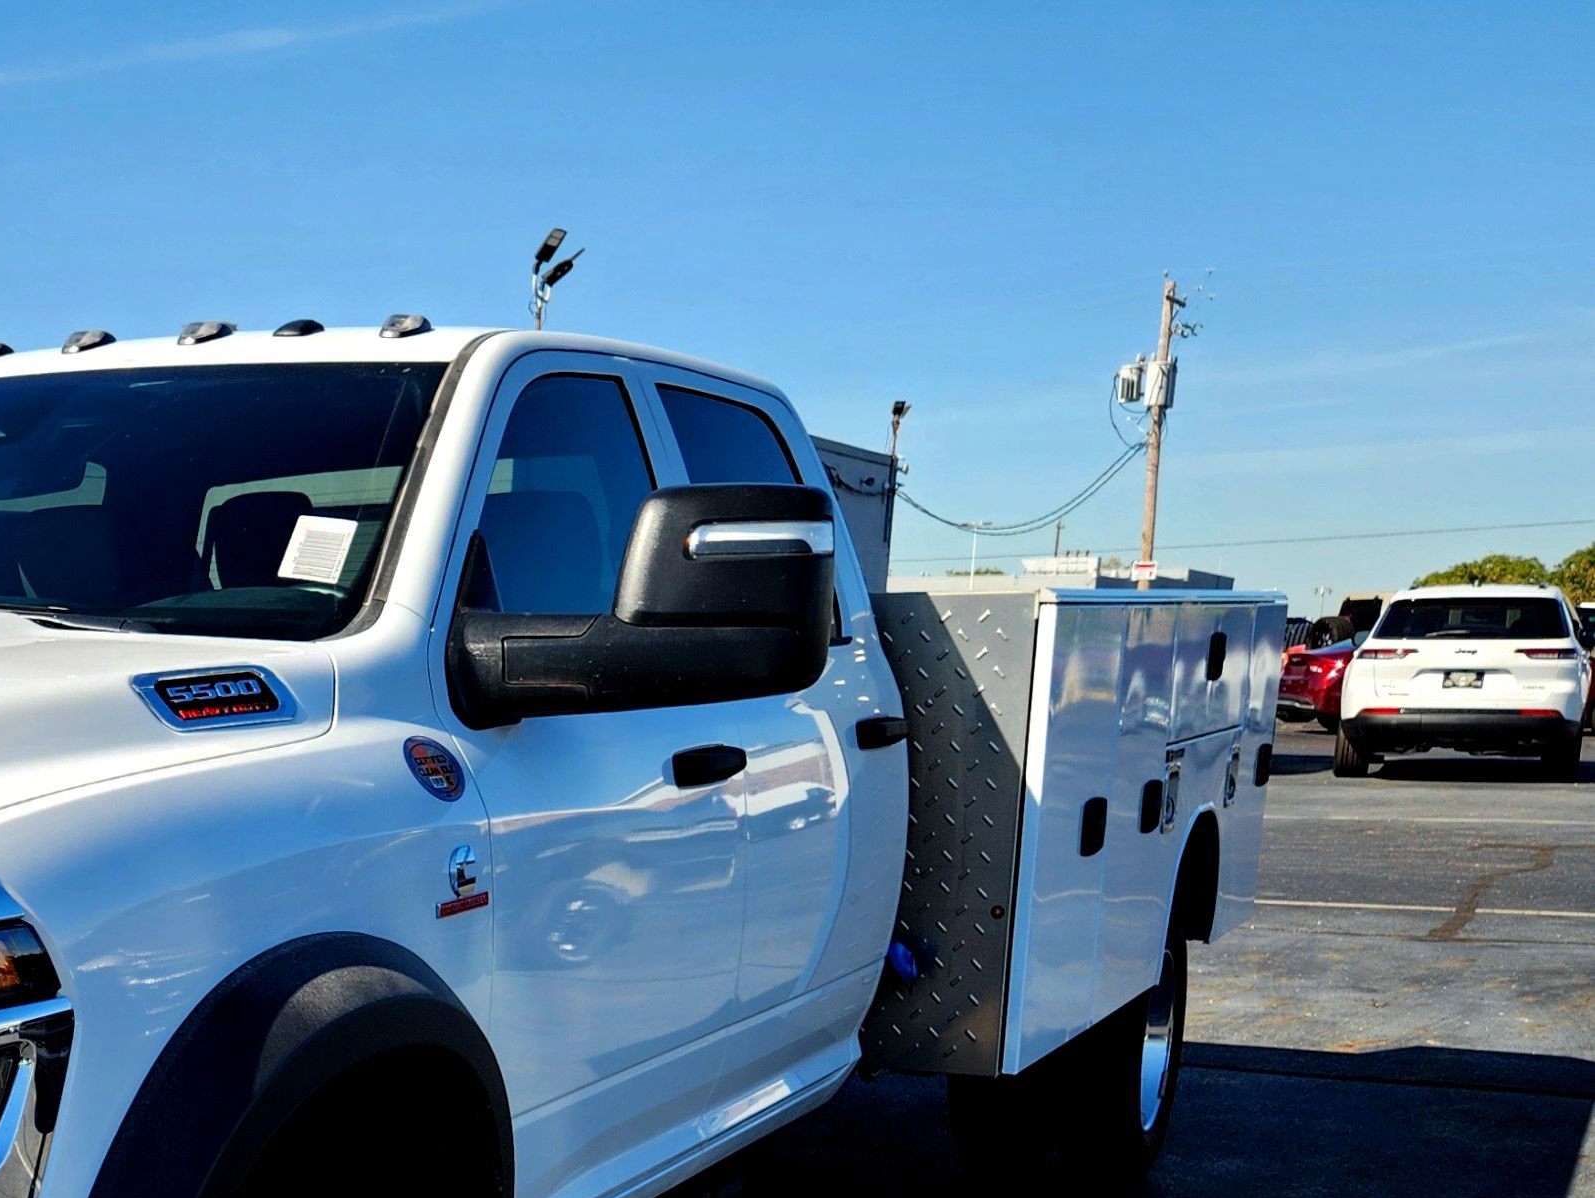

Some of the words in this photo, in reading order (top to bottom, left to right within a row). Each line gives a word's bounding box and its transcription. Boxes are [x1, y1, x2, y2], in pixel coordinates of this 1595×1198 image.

[1454, 648, 1478, 656] Jeep
[166, 679, 262, 704] 5500
[178, 705, 230, 720] HEAVY
[414, 754, 447, 766] CERTIFIED
[418, 767, 442, 777] CLEAN
[440, 764, 457, 774] IDLE
